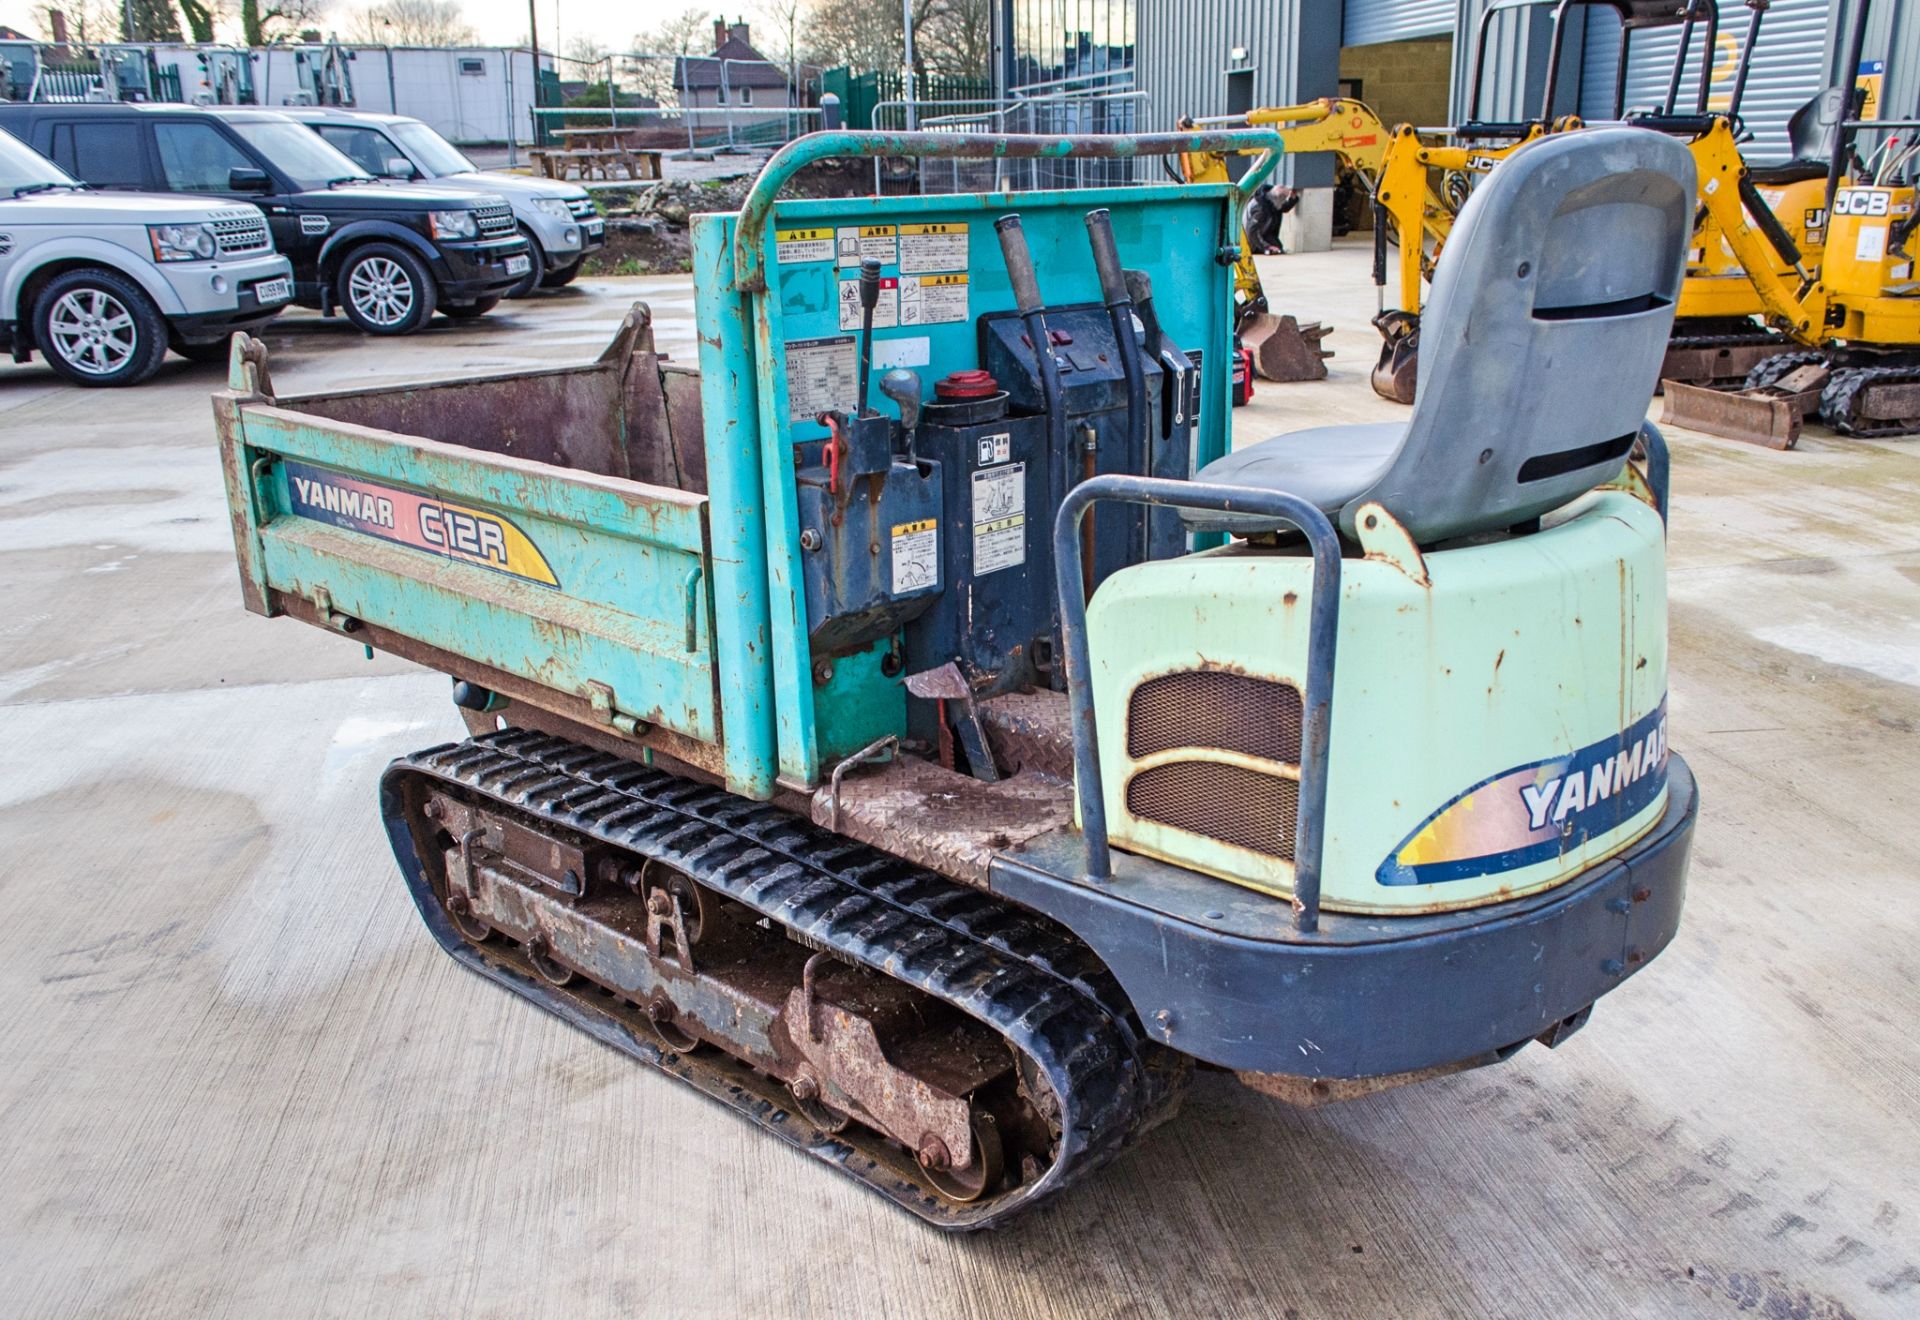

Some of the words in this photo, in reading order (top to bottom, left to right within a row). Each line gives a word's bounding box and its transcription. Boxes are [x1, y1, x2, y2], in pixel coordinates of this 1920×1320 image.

[1834, 190, 1890, 215] JCB
[295, 477, 395, 529] YANMAR
[418, 502, 508, 565] C12R
[1520, 714, 1667, 831] YANMAR
